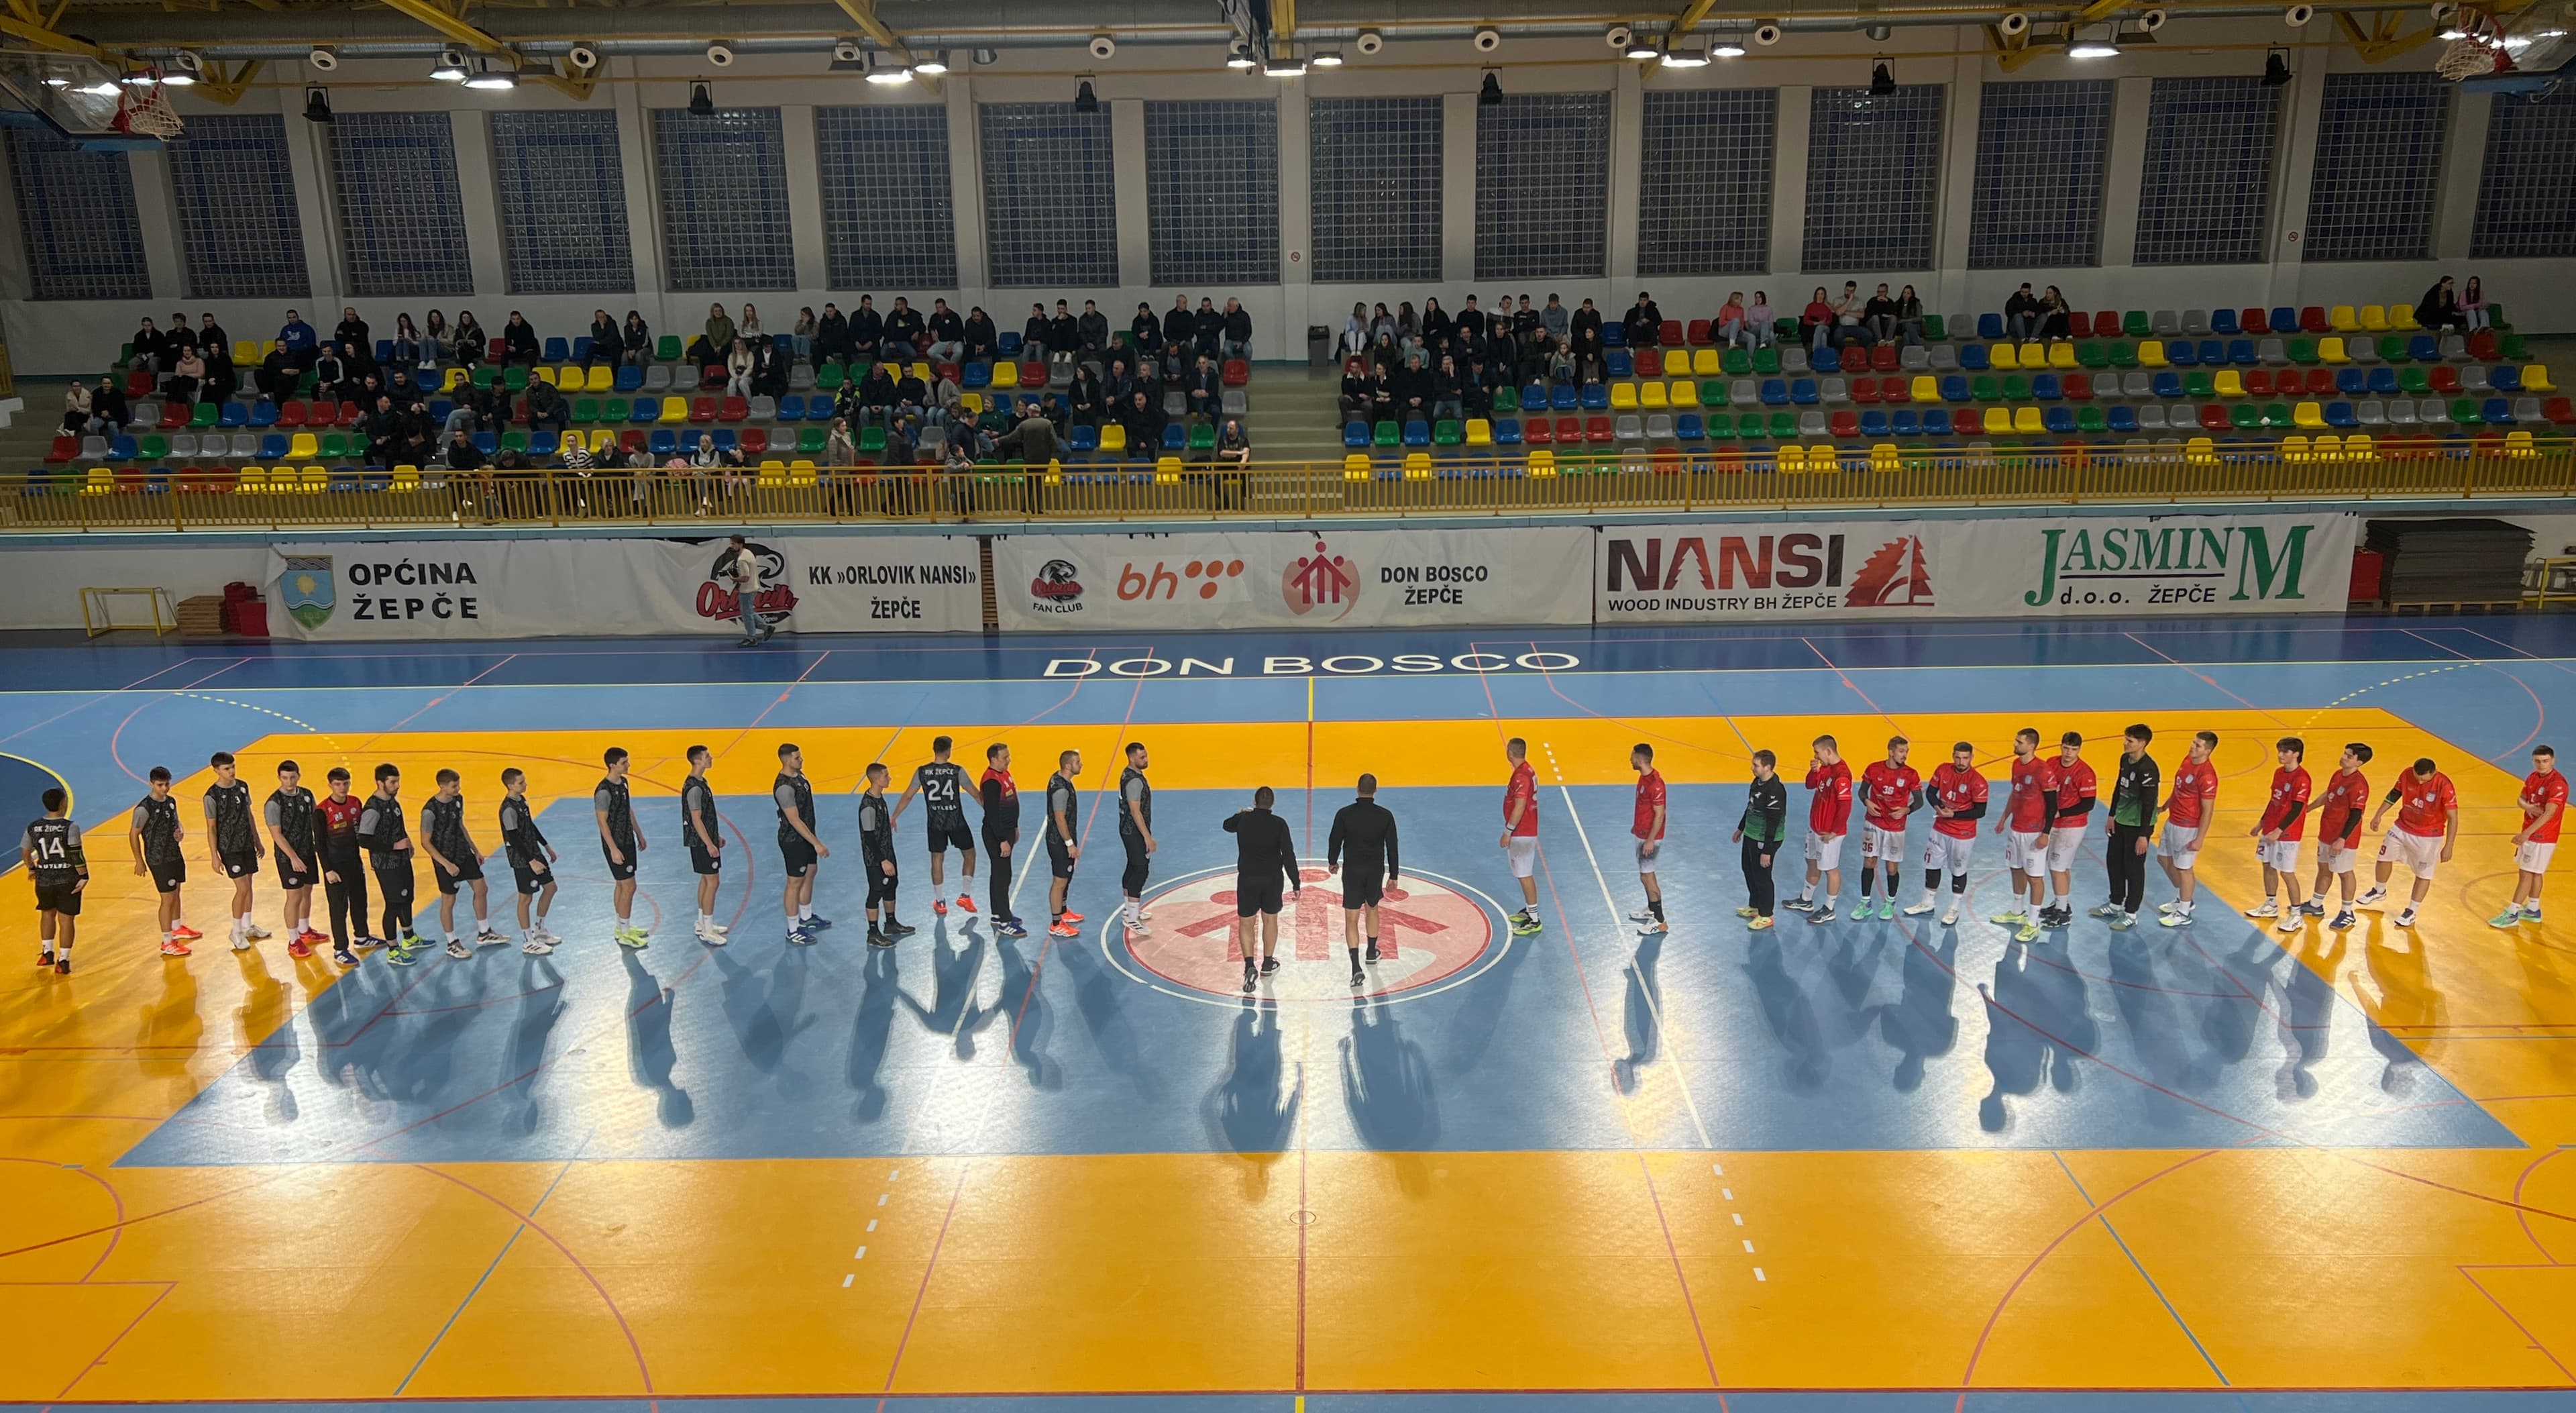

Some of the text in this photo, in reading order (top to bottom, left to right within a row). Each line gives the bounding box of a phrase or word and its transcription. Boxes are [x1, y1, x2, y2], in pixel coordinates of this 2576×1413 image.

[349, 558, 477, 586] OPĆINA
[1607, 533, 1845, 592] NANSI
[2025, 525, 2314, 607] JASMIN M
[809, 566, 977, 585] KK »ORLOVIK NANSI»
[1117, 562, 1178, 600] bh
[1381, 566, 1488, 583] DON BOSCO
[696, 580, 800, 620] Orlvik
[1405, 585, 1463, 606] ŽEPČE
[1608, 592, 1837, 612] WOOD INDUSTRY BH ŽEPČE
[2060, 584, 2217, 605] d.o.o. ŽEPČE
[354, 592, 478, 620] ŽEPČE
[871, 596, 921, 619] ŽEPČE
[1033, 603, 1083, 613] FAN CLUB
[1043, 653, 1580, 678] DON BOSCO
[935, 768, 955, 776] ŽEPČE
[926, 780, 955, 801] 24
[1947, 790, 1956, 801] 41
[165, 810, 170, 819] 5
[38, 837, 66, 860] 14
[1862, 842, 1873, 853] 36
